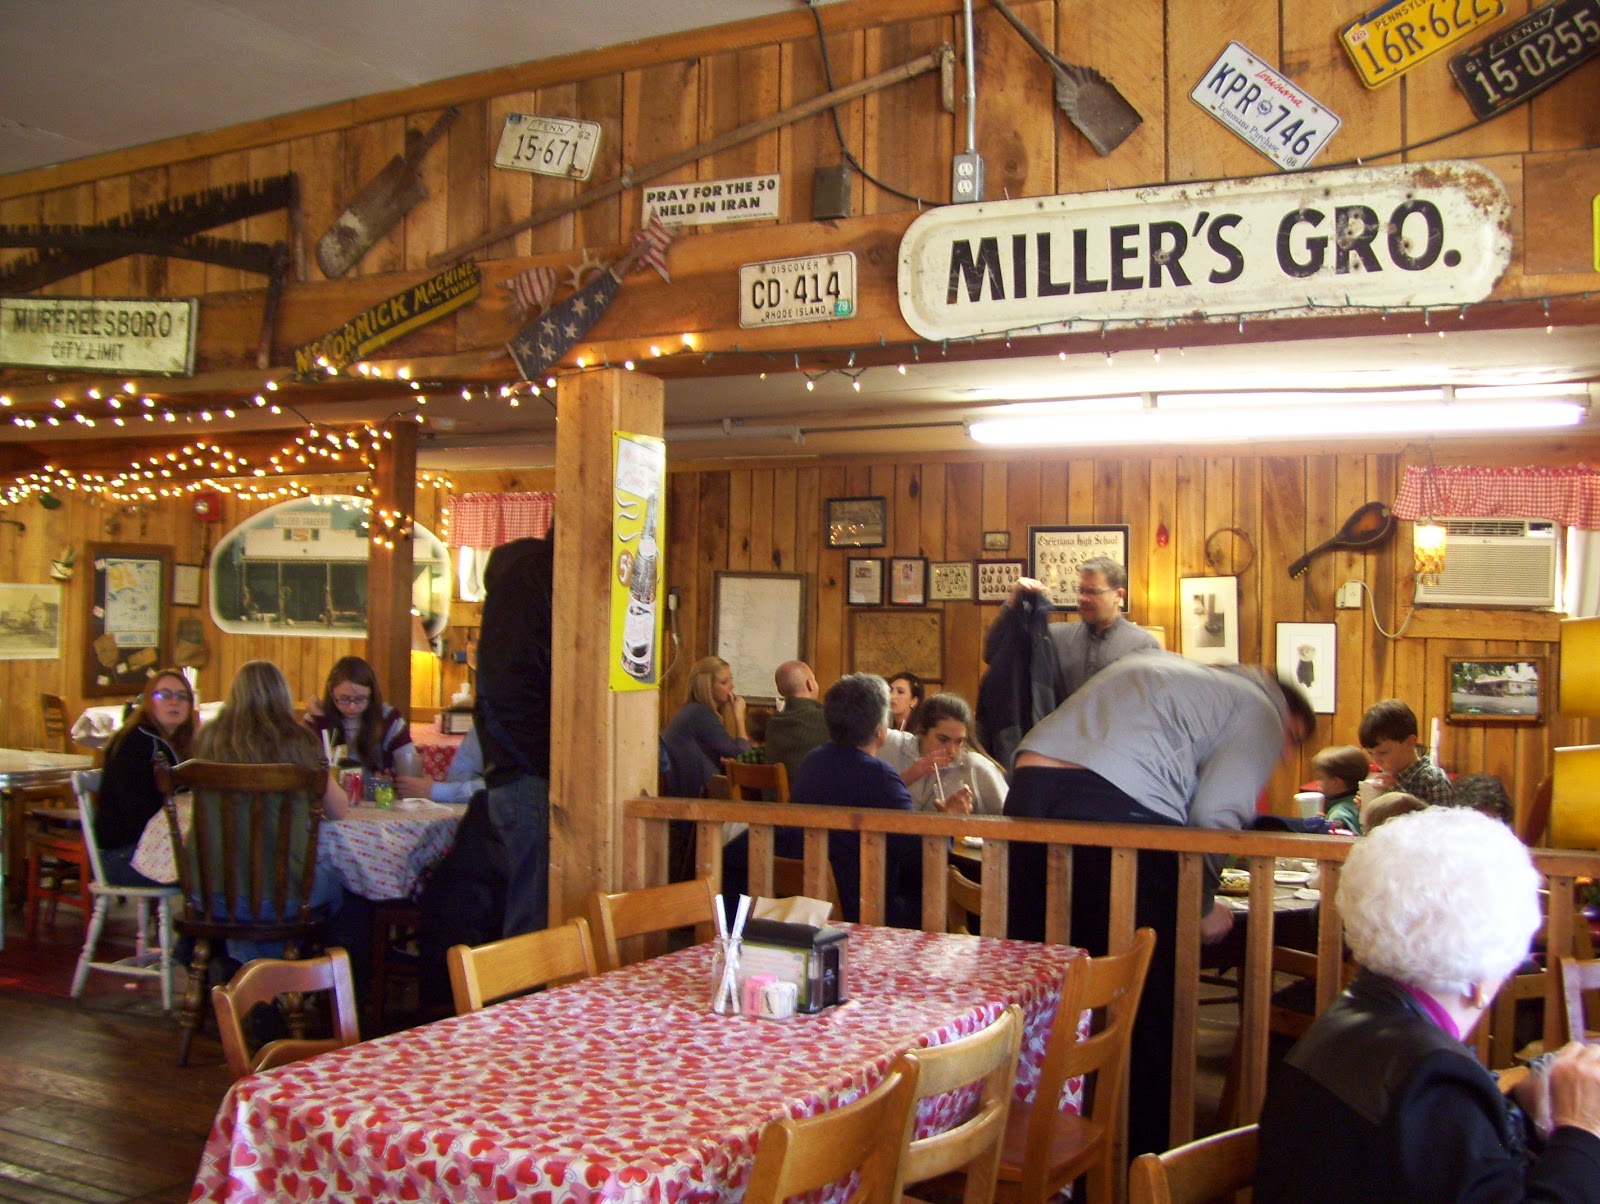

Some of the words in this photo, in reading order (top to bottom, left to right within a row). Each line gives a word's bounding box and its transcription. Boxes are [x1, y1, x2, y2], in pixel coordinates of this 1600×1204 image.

[1504, 20, 1544, 46] TENN
[1254, 67, 1302, 108] Louisiana
[1207, 62, 1262, 115] KPR
[1263, 104, 1317, 156] 746
[537, 122, 565, 133] TENN
[1217, 101, 1249, 130] Louisiana
[1249, 124, 1279, 153] Purchase
[646, 188, 689, 203] PRAY
[693, 185, 722, 199] FOR
[725, 181, 753, 195] THE
[757, 178, 776, 192] 50
[660, 203, 696, 217] HELD
[700, 201, 716, 213] IN
[721, 197, 760, 211] IRAN
[946, 210, 1245, 305] MILLER'S
[1276, 199, 1462, 279] GRO.
[771, 261, 819, 274] DISCOVER
[442, 274, 478, 300] TWINE
[765, 309, 793, 320] RHODE
[795, 305, 826, 317] ISLAND
[837, 301, 848, 311] 79
[13, 307, 172, 338] MURFREESBORO
[51, 340, 82, 359] CITY
[85, 343, 124, 362] LIMIT
[1076, 534, 1092, 546] High
[1094, 534, 1118, 546] School
[1052, 594, 1077, 604] Senio
